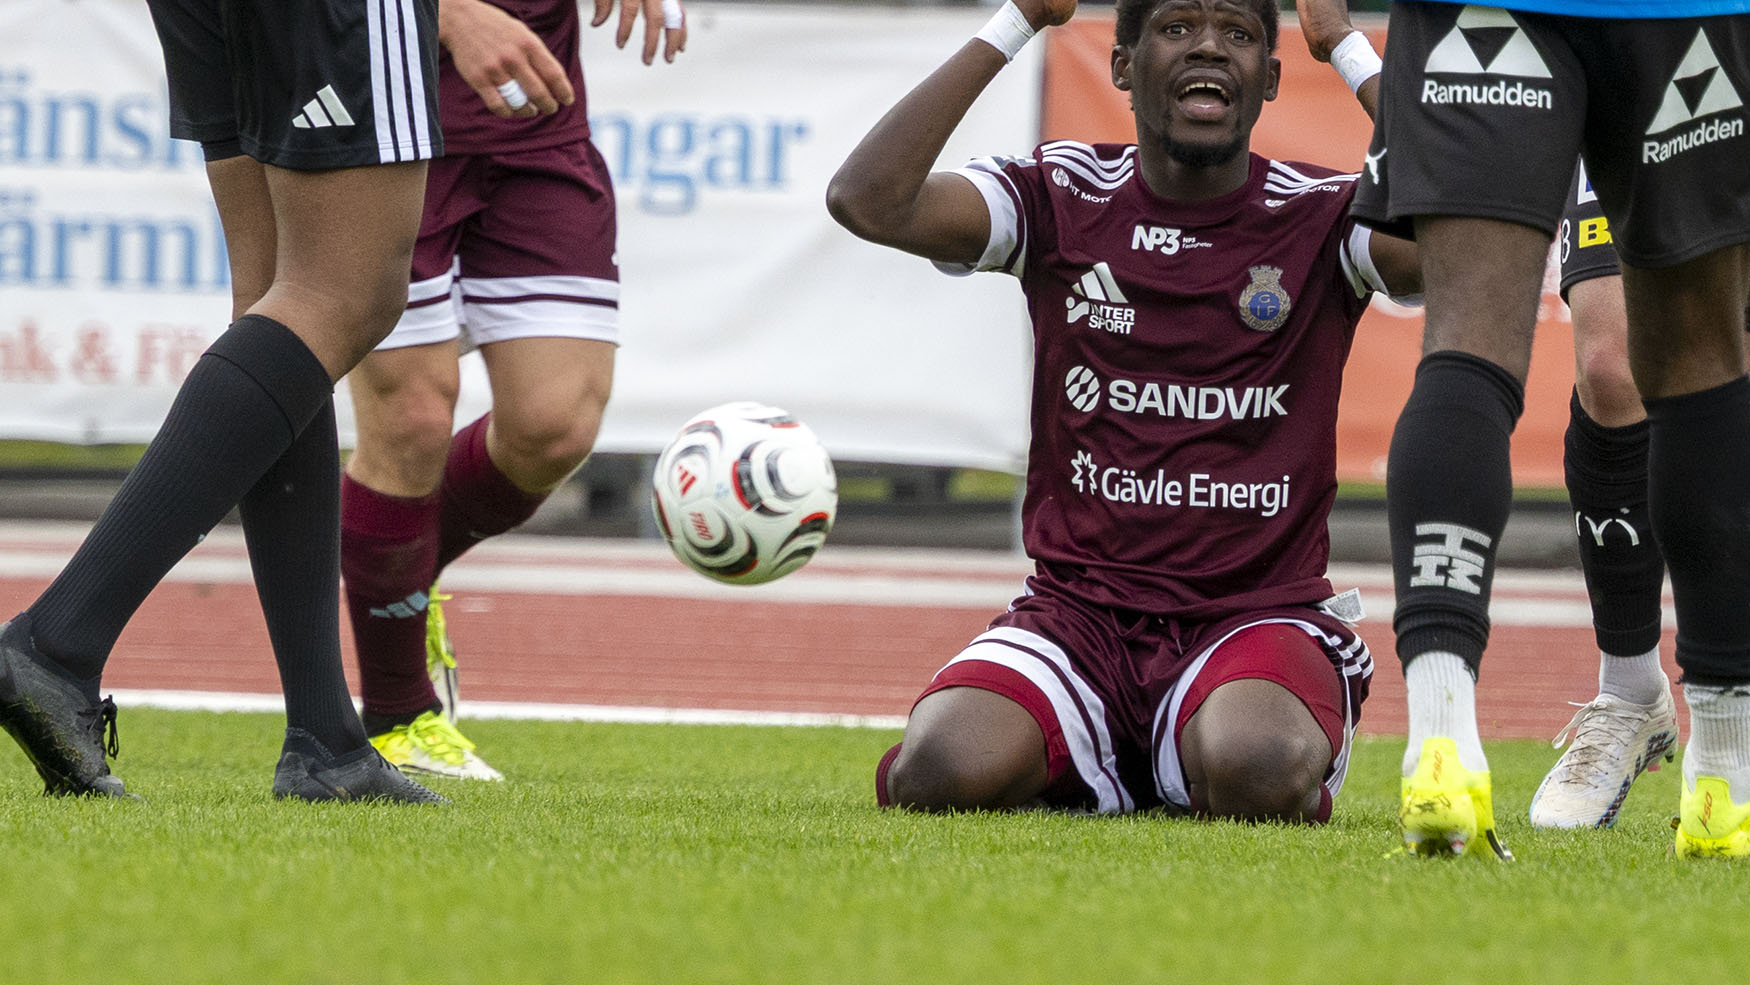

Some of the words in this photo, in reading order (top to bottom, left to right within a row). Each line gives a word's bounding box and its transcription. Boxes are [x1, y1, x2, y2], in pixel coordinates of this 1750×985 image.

[1421, 80, 1553, 109] Ramudden
[1642, 116, 1744, 164] Ramudden
[1131, 225, 1182, 255] NP3
[1579, 216, 1613, 248] B
[1088, 315, 1135, 334] SPORT
[1092, 304, 1135, 322] INTER
[1109, 379, 1290, 420] SANDVIK
[1101, 467, 1182, 507] Gävle
[1189, 473, 1290, 517] Energi
